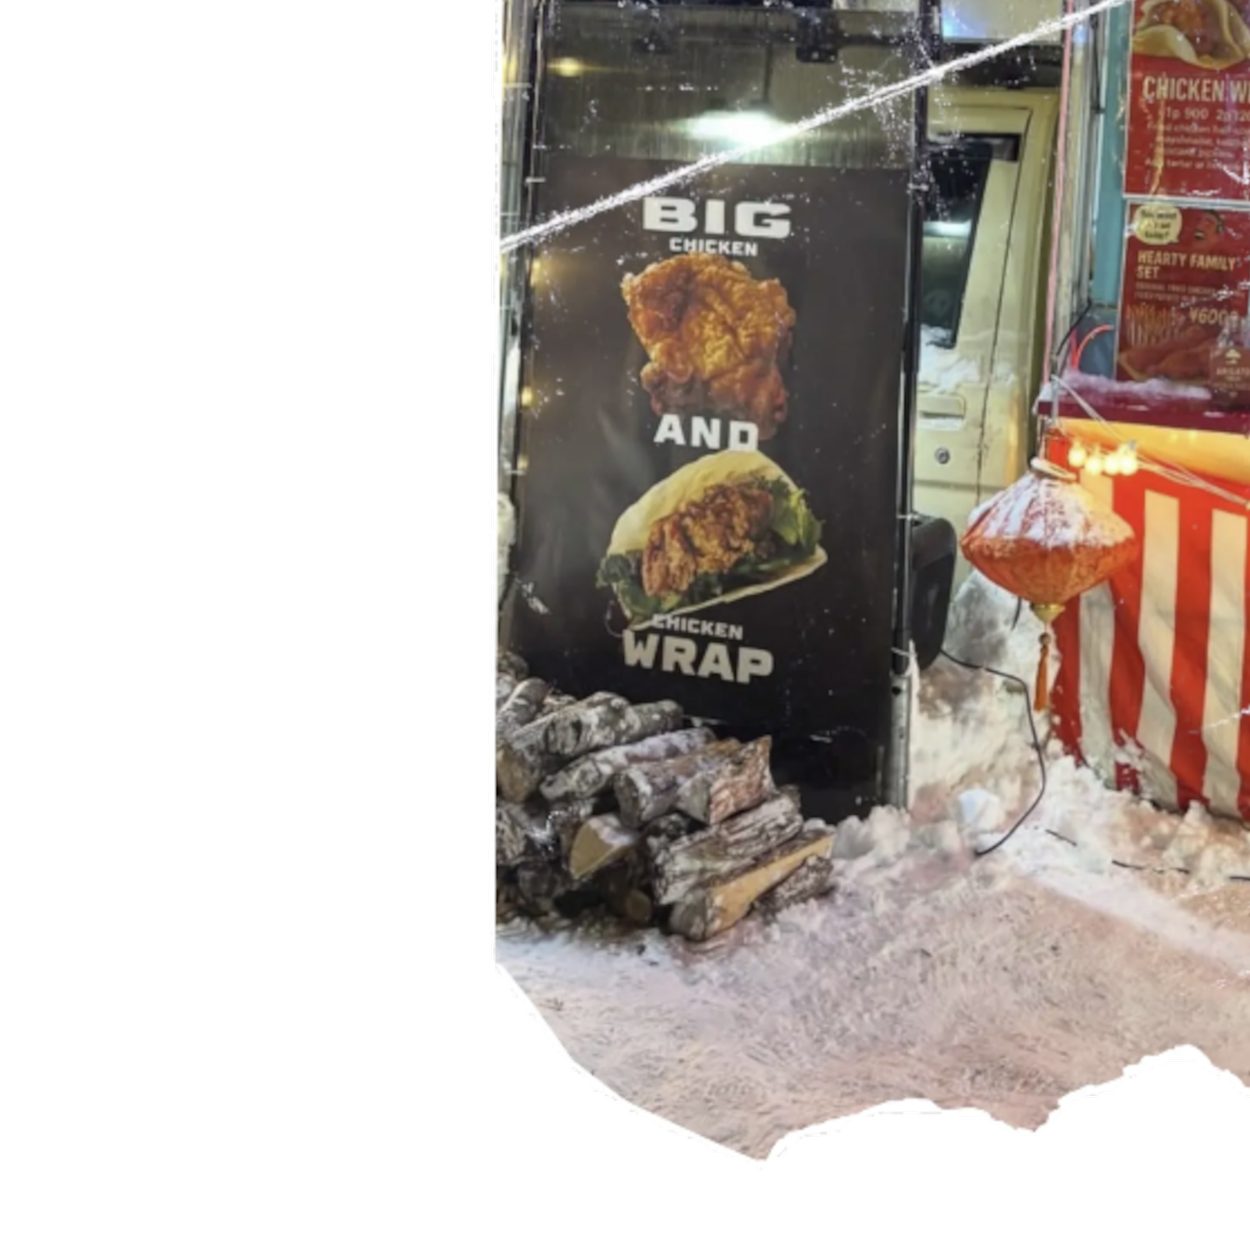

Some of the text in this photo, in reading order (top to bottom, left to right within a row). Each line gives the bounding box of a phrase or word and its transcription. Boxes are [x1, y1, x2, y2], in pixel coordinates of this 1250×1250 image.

[1143, 75, 1225, 102] CHICKEN
[1184, 107, 1209, 120] 900
[643, 197, 791, 239] BIG
[669, 237, 758, 256] CHICKEN
[1136, 265, 1160, 280] SET
[1137, 250, 1236, 272] HEARTY FAMILY
[653, 413, 759, 452] AND
[652, 613, 744, 641] CHICKEN
[622, 628, 774, 684] WRAP
